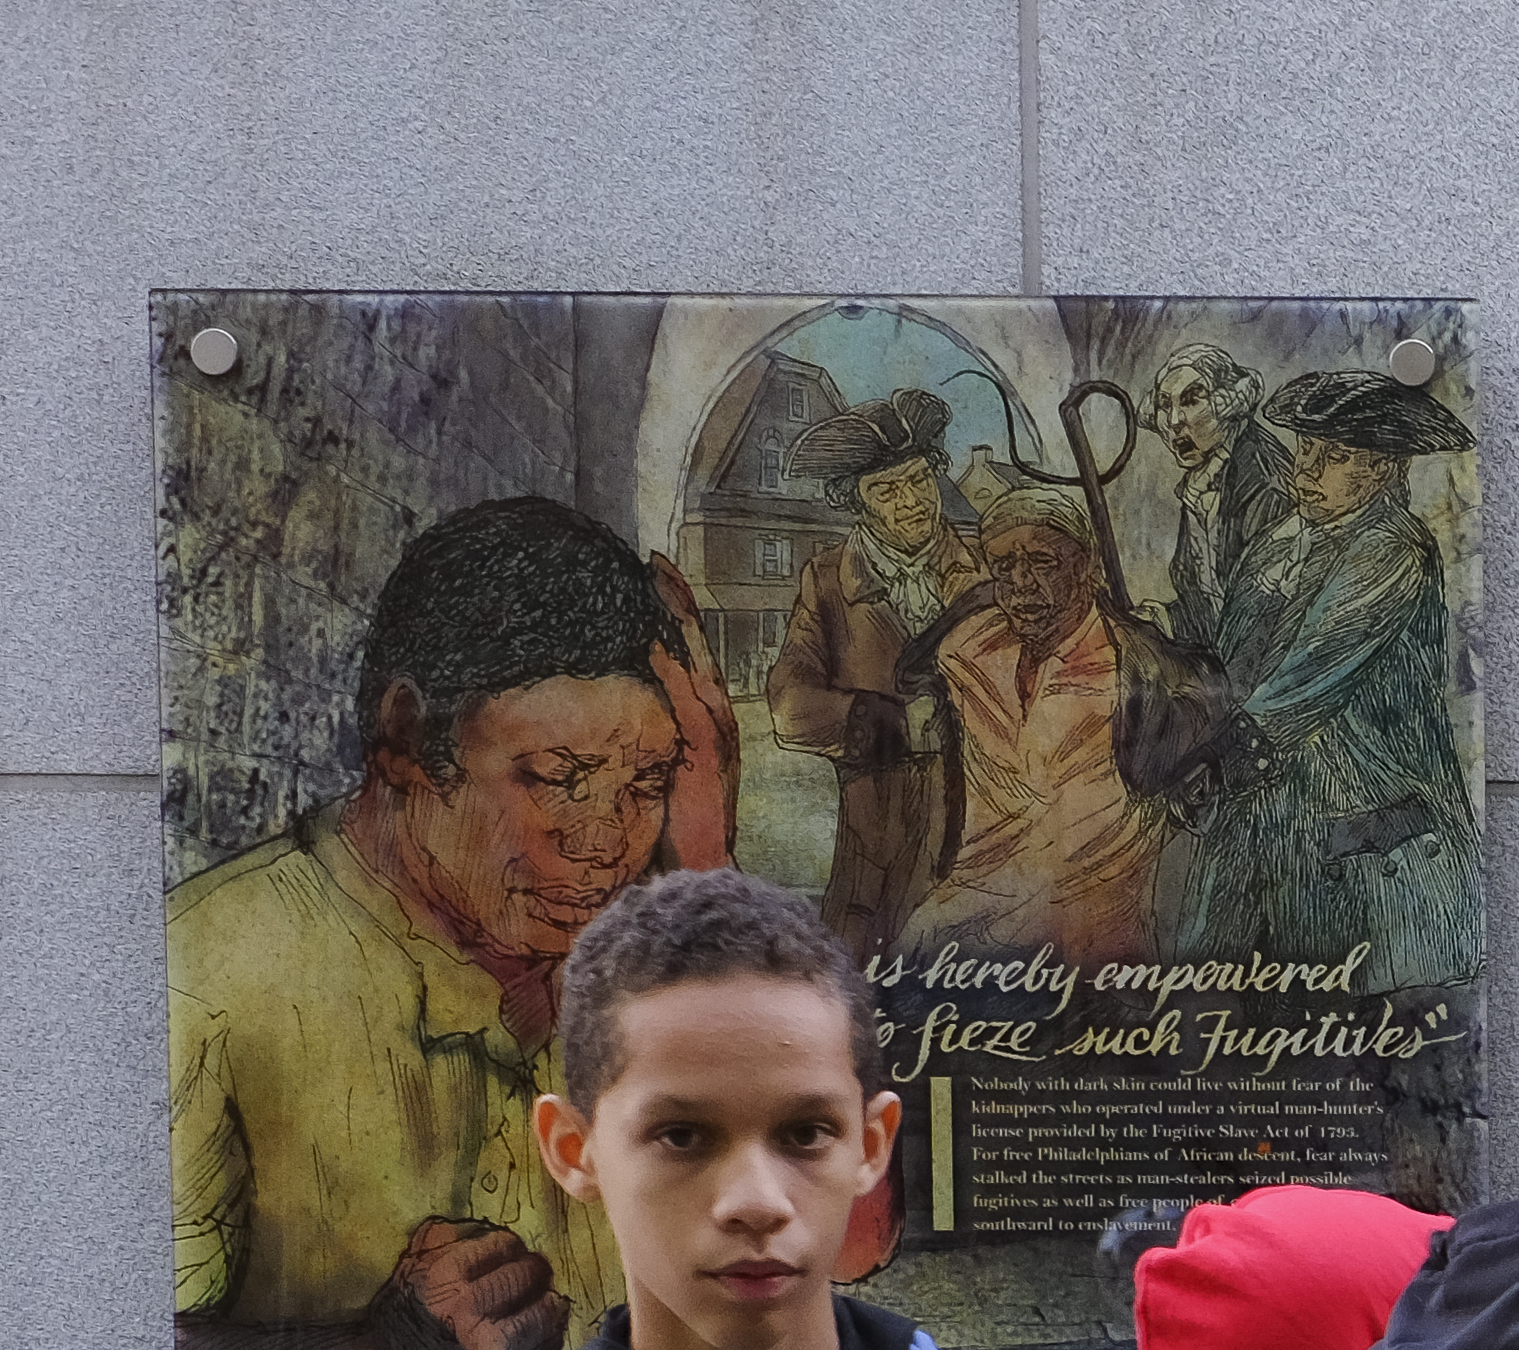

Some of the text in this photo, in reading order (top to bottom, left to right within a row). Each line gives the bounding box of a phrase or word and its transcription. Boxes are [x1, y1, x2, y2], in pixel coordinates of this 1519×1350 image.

[865, 938, 1372, 1020] is hereby empowered
[1054, 1009, 1183, 1059] such
[970, 1076, 1374, 1095] Nobody with dark skin could live without fear of the
